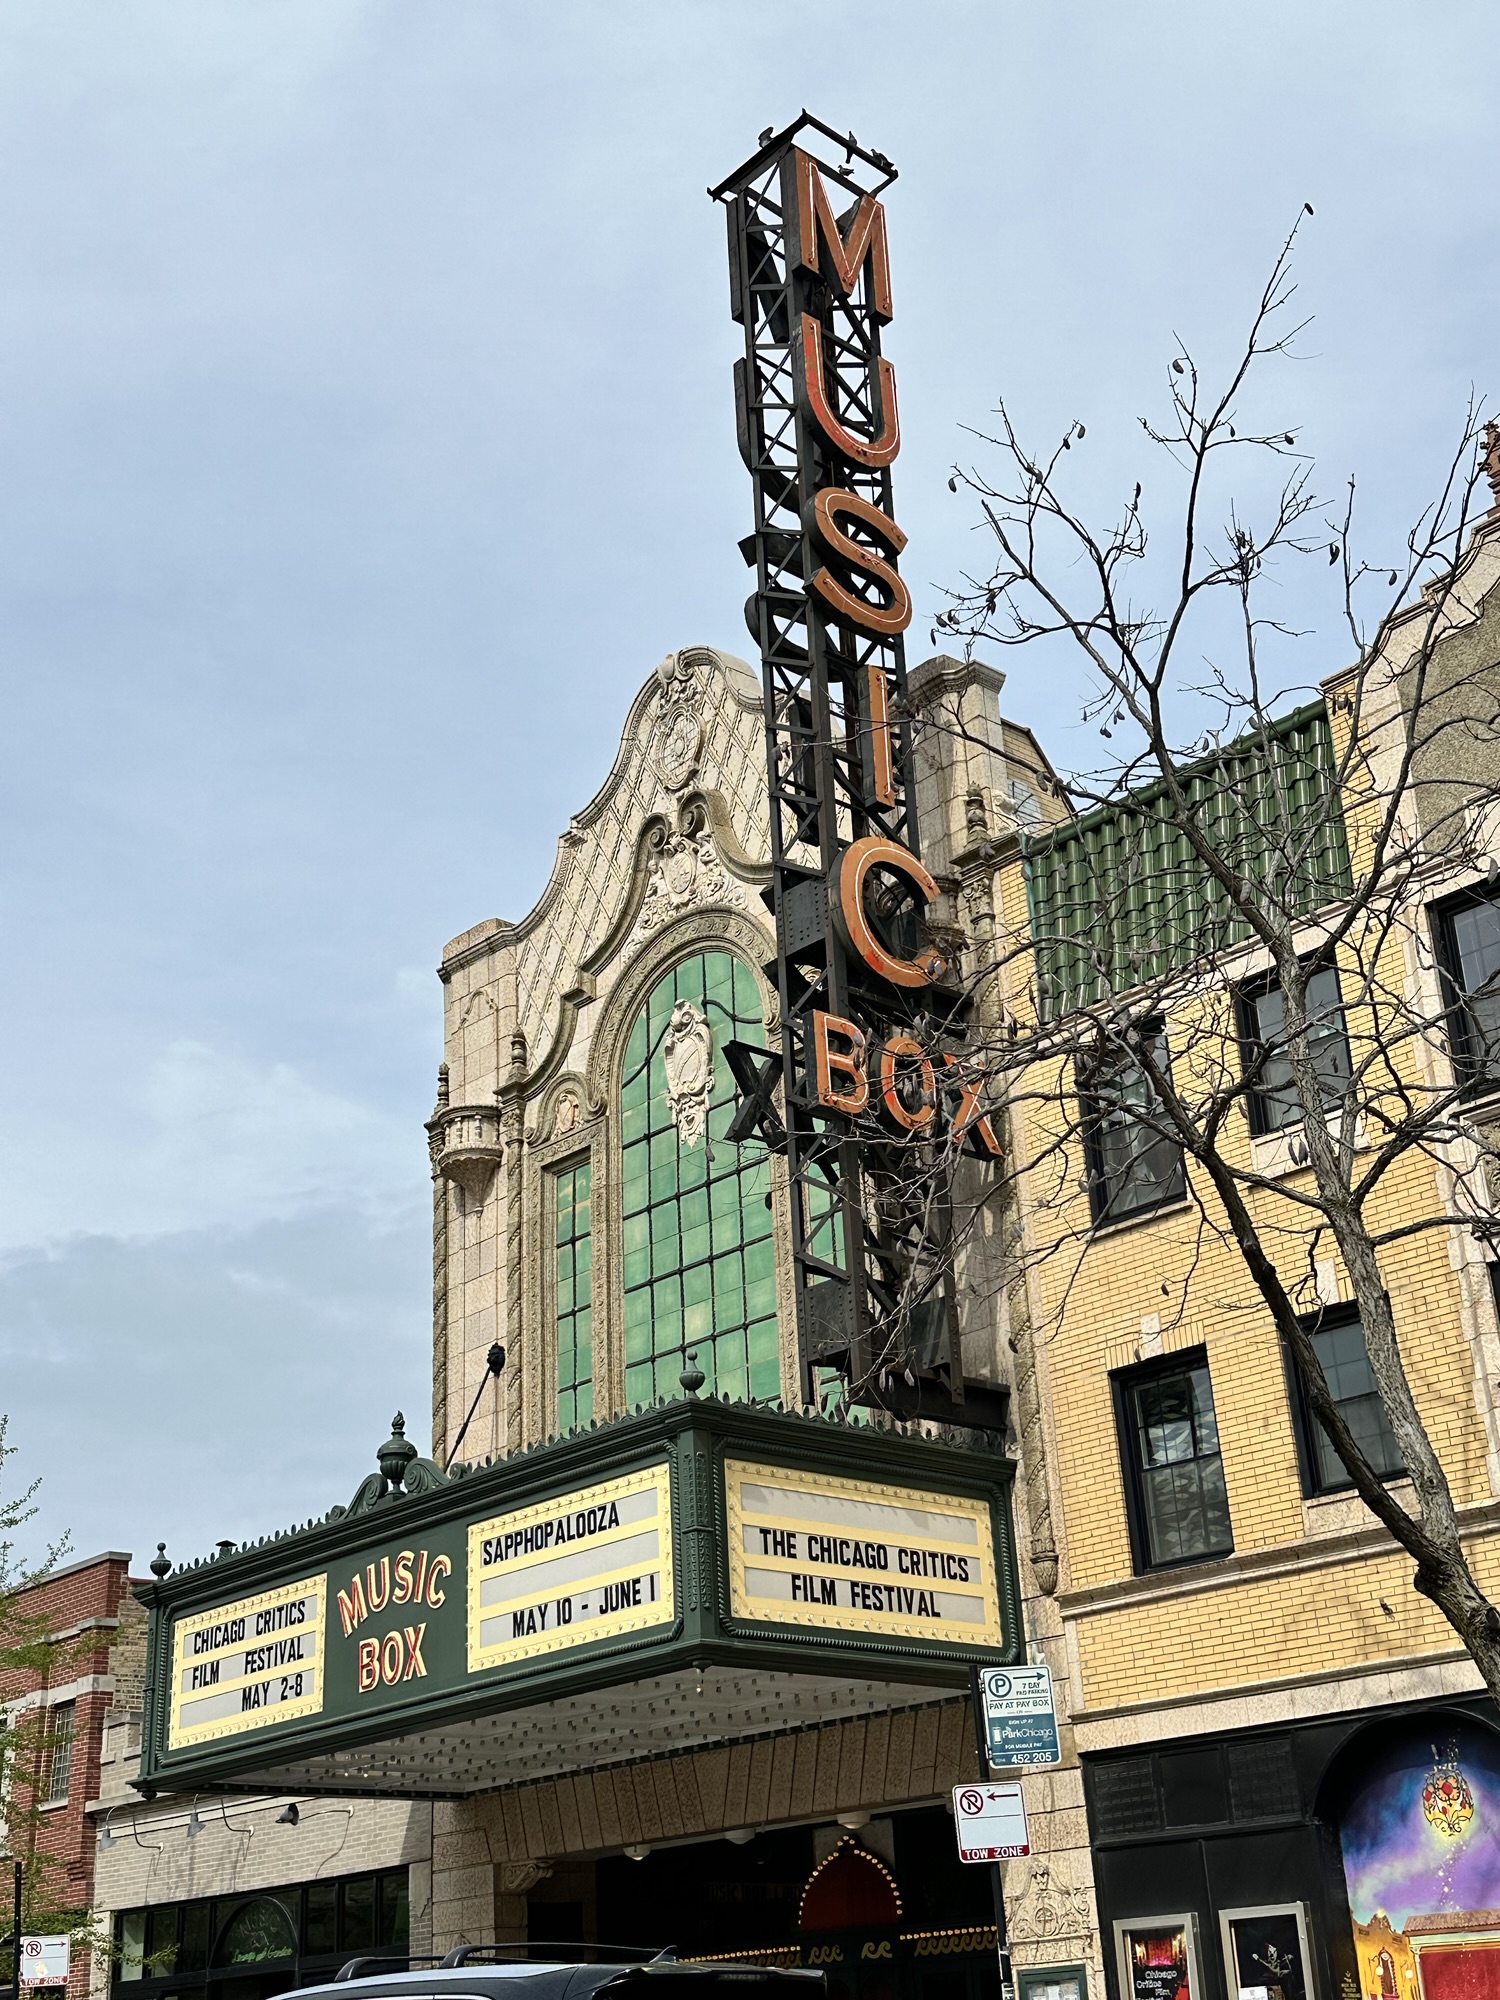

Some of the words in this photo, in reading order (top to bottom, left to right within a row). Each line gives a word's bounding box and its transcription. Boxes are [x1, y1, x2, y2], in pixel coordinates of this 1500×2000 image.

[790, 146, 947, 988] MUSIC
[815, 1009, 1003, 1160] BOX
[483, 1501, 620, 1566] SAPPHOPALOOZA
[759, 1528, 797, 1559] THE
[807, 1535, 889, 1570] CHICAGO
[898, 1548, 969, 1582] CRITICS
[337, 1550, 452, 1638] MUSIC
[512, 1603, 548, 1638] MAY
[556, 1597, 572, 1626] 10
[599, 1578, 642, 1615] JUNE
[650, 1574, 656, 1602] 1
[791, 1574, 837, 1606] FILM
[850, 1581, 941, 1618] FESTIVAL
[193, 1618, 246, 1655] CHICAGO
[255, 1600, 306, 1636] CRITICS
[192, 1660, 220, 1690] FILM
[244, 1636, 304, 1675] FESTIVAL
[359, 1622, 427, 1693] BOX
[241, 1682, 270, 1712] MAY
[280, 1674, 303, 1701] 2-8
[989, 1702, 1003, 1710] PAY
[1005, 1701, 1014, 1709] AT
[1016, 1700, 1030, 1708] PAY
[1032, 1699, 1049, 1707] BOX
[1002, 1727, 1053, 1739] ParkChicago
[1011, 1753, 1030, 1764] 452
[1033, 1752, 1052, 1762] 205
[965, 1848, 988, 1860] TOW
[993, 1846, 1024, 1858] ZONE
[25, 1978, 40, 1986] TOW
[44, 1976, 65, 1984] ZONE
